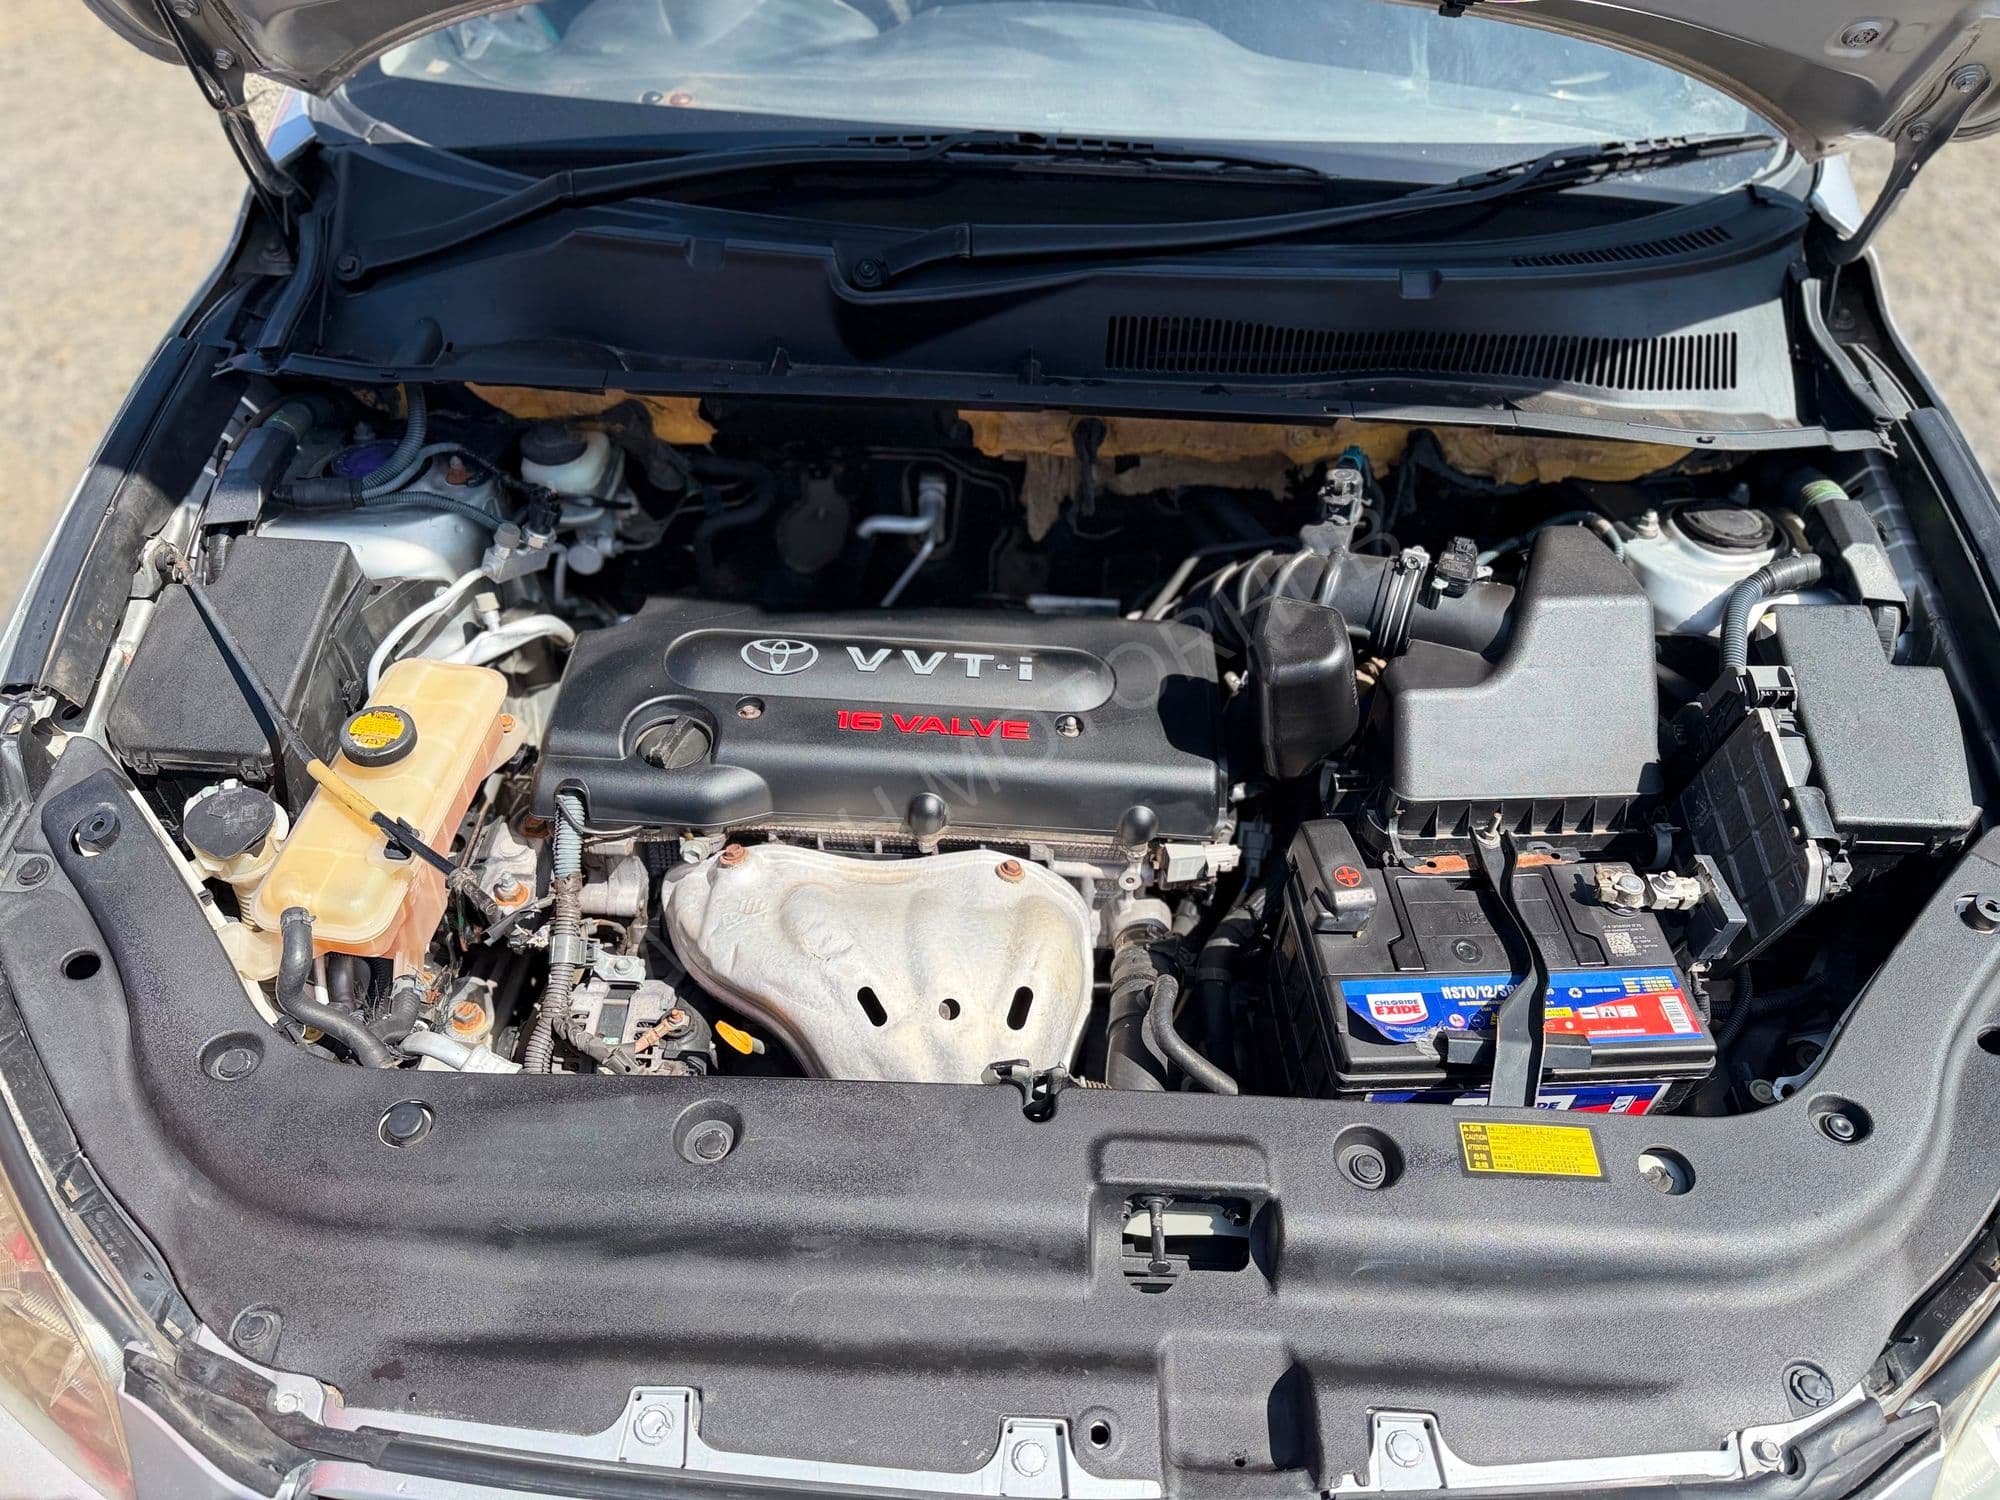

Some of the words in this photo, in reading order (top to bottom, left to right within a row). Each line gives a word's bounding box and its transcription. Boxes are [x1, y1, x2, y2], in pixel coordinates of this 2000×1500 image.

[845, 646, 1033, 681] VVT-i
[837, 709, 883, 731] 16
[891, 712, 1031, 740] VALVE
[1375, 1005, 1421, 1015] EXIDE
[1464, 1133, 1487, 1141] CAUTION
